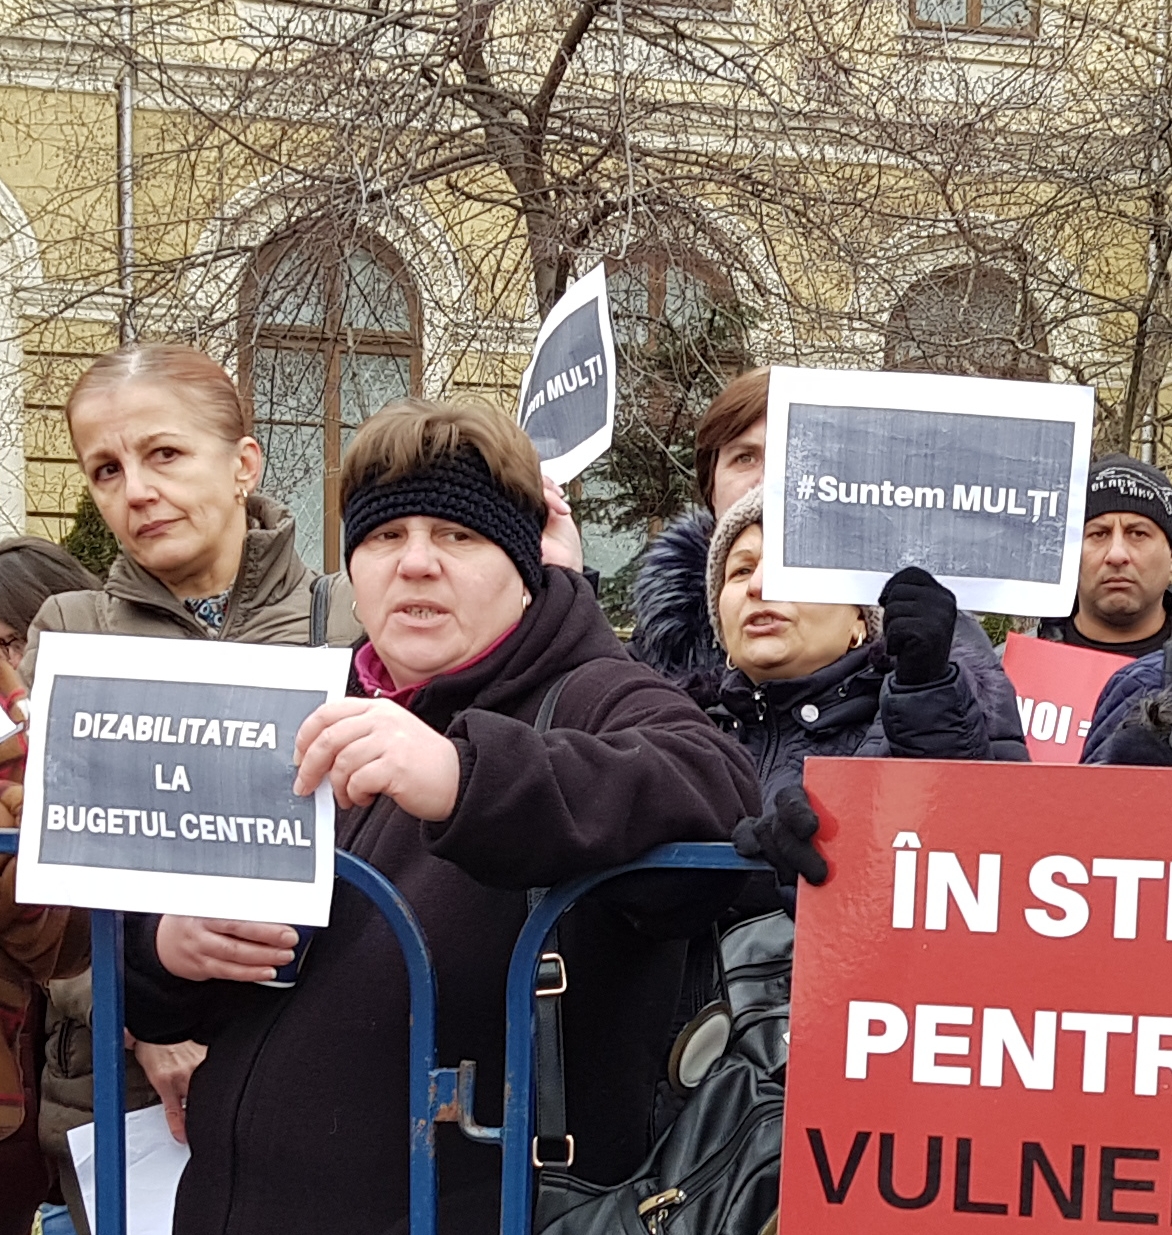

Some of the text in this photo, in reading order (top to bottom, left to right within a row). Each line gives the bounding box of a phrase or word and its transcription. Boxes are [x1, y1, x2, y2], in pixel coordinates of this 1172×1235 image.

[797, 474, 1058, 523] #Suntem MULȚI
[73, 712, 278, 749] DIZABILITATEA
[155, 764, 191, 792] LA
[47, 805, 311, 847] BUGETUL CENTRAL
[893, 831, 1000, 933] ÎN
